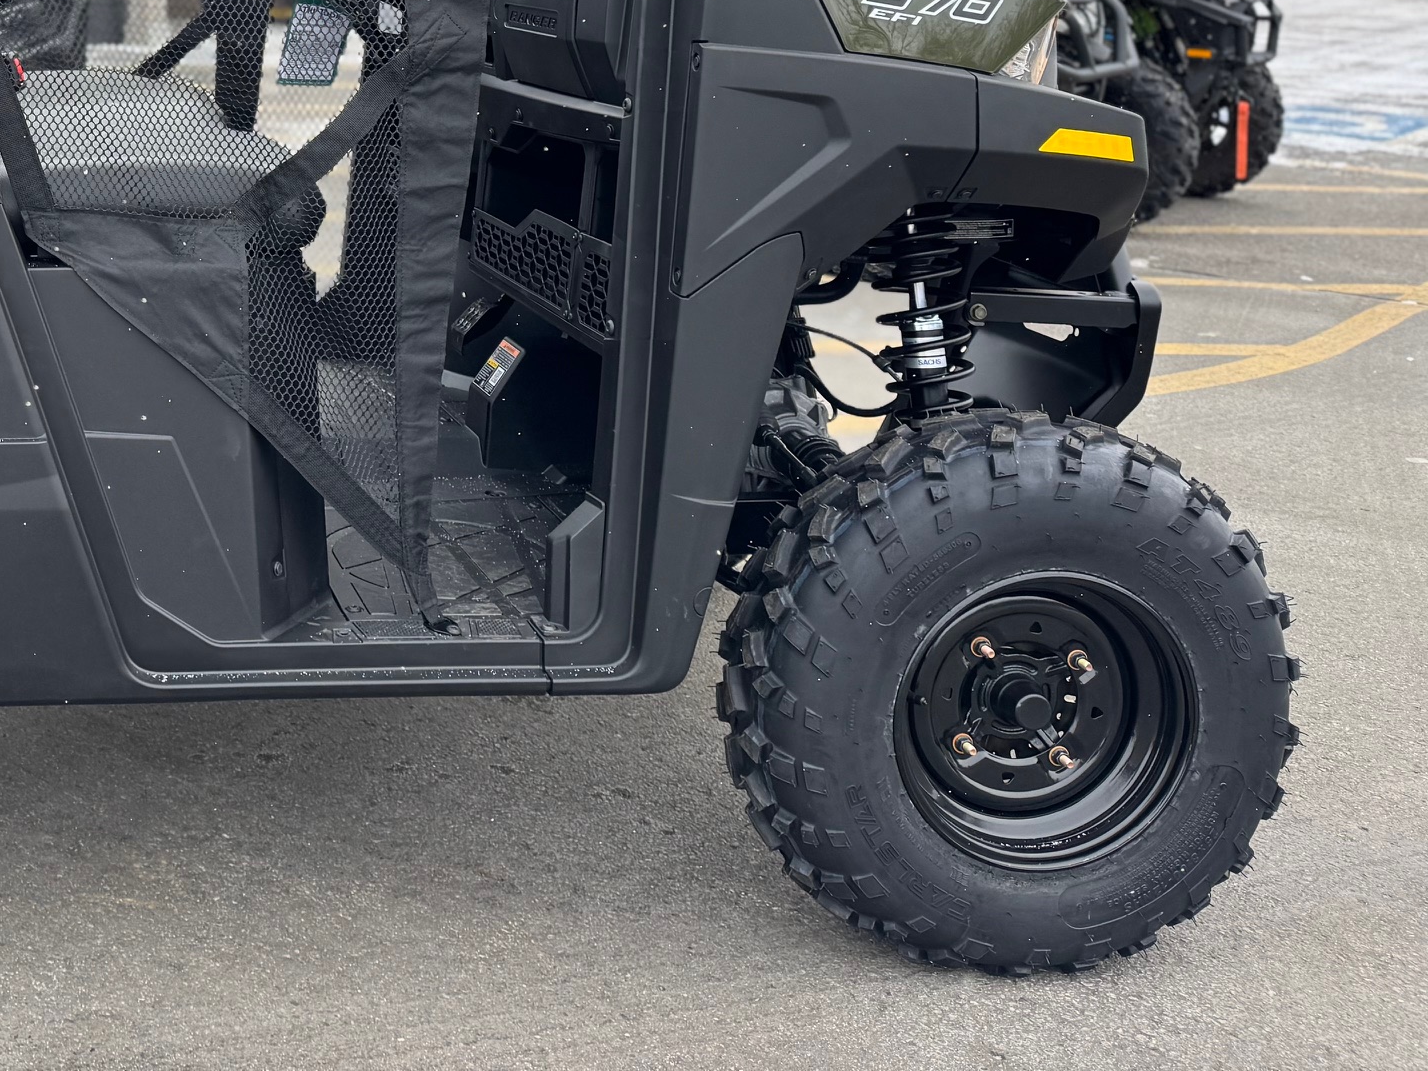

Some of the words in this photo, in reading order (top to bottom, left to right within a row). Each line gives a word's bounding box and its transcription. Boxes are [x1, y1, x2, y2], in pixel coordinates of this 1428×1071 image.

[510, 10, 557, 30] RANGER
[869, 8, 922, 25] EFI
[1136, 537, 1252, 660] AT489
